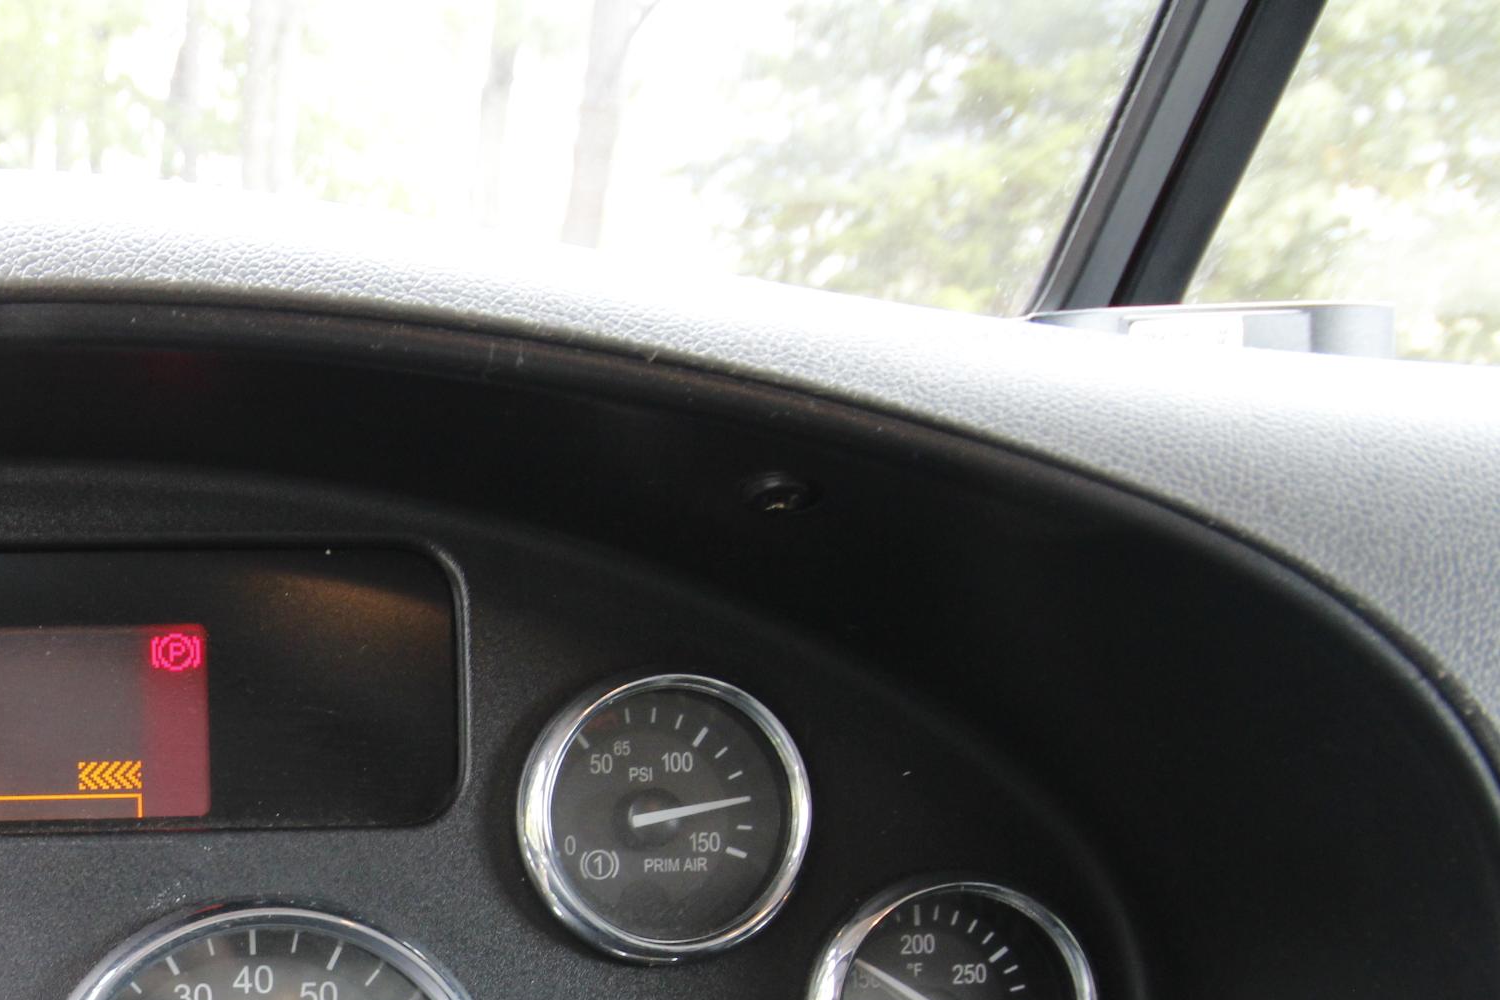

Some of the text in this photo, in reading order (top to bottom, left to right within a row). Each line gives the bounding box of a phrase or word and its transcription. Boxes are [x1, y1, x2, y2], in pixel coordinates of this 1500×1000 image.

[614, 741, 631, 756] 65
[590, 754, 613, 775] 50
[661, 752, 693, 772] 100
[629, 767, 653, 782] PSI
[565, 836, 576, 855] 0
[689, 832, 720, 852] 150
[644, 857, 708, 873] PRIM AIR
[900, 934, 935, 954] 200
[232, 965, 274, 995] 40
[952, 964, 987, 984] 250
